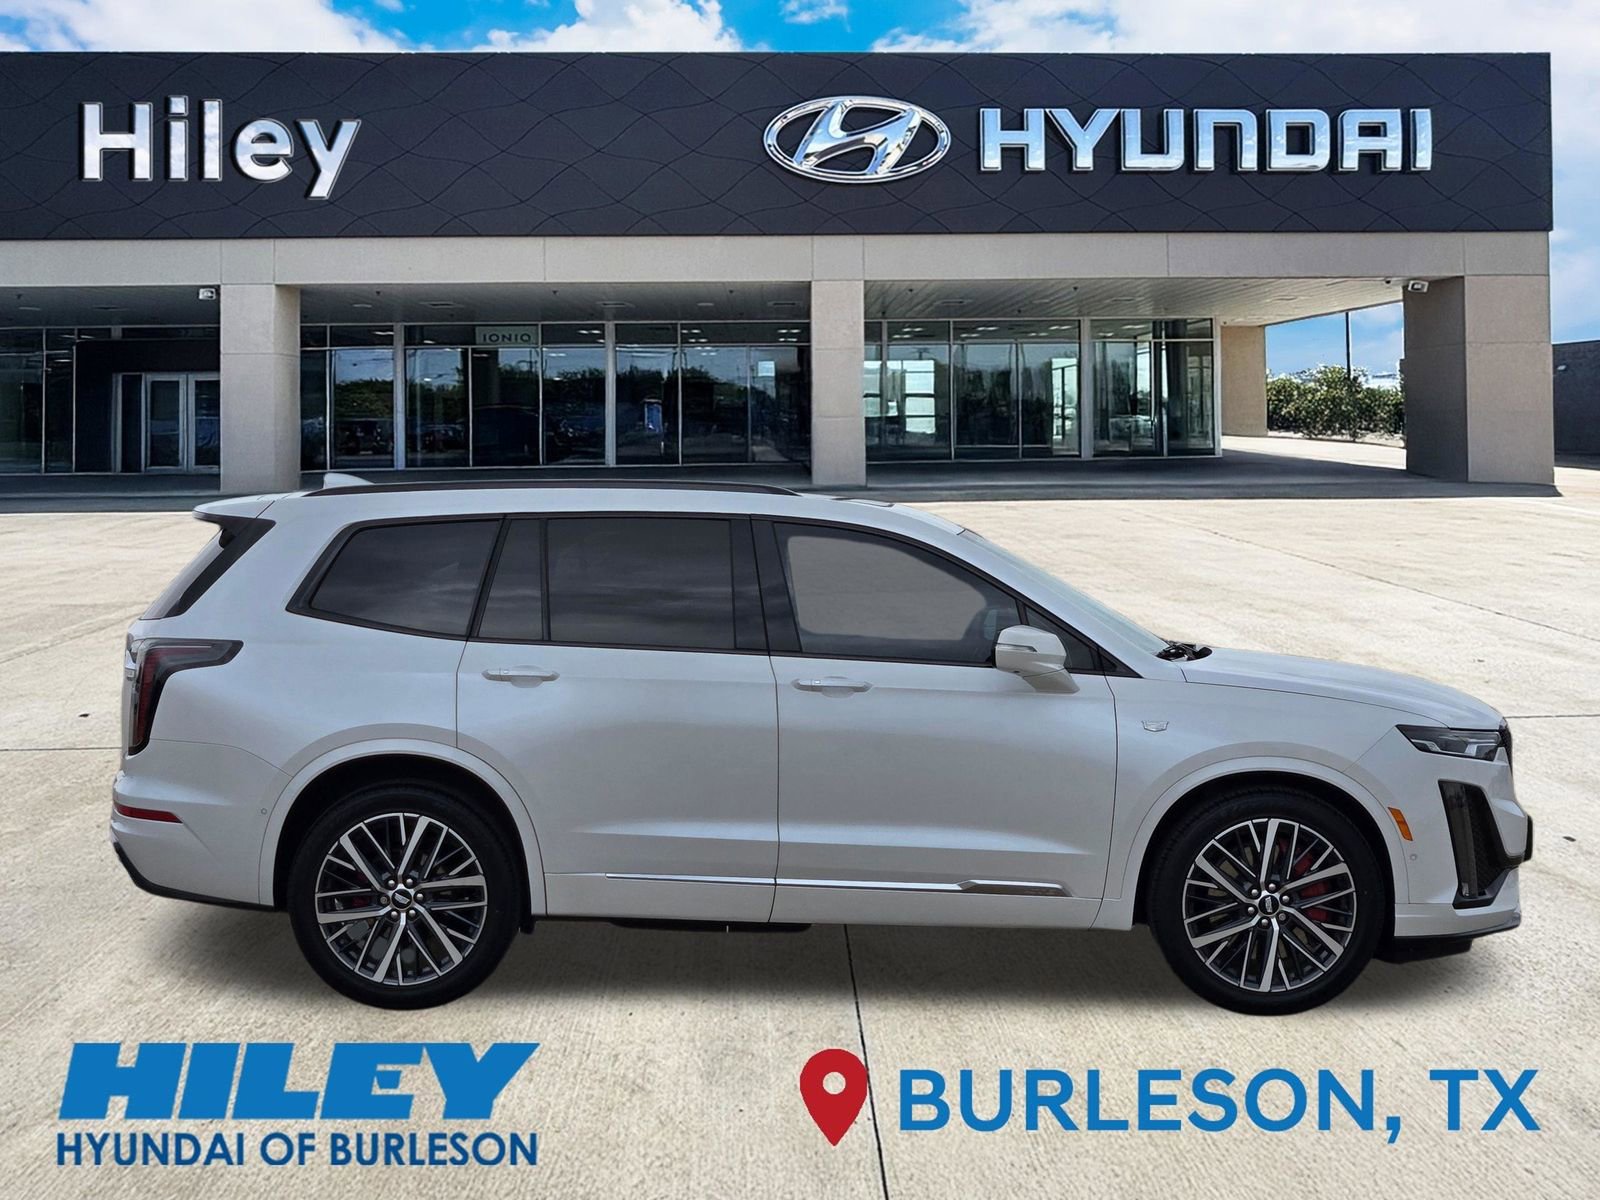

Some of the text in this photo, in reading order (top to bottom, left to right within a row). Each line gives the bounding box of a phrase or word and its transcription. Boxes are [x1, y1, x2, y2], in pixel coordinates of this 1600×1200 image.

[82, 95, 362, 199] Hiley
[979, 107, 1433, 172] HYUNDAI
[482, 332, 532, 343] IONIQ
